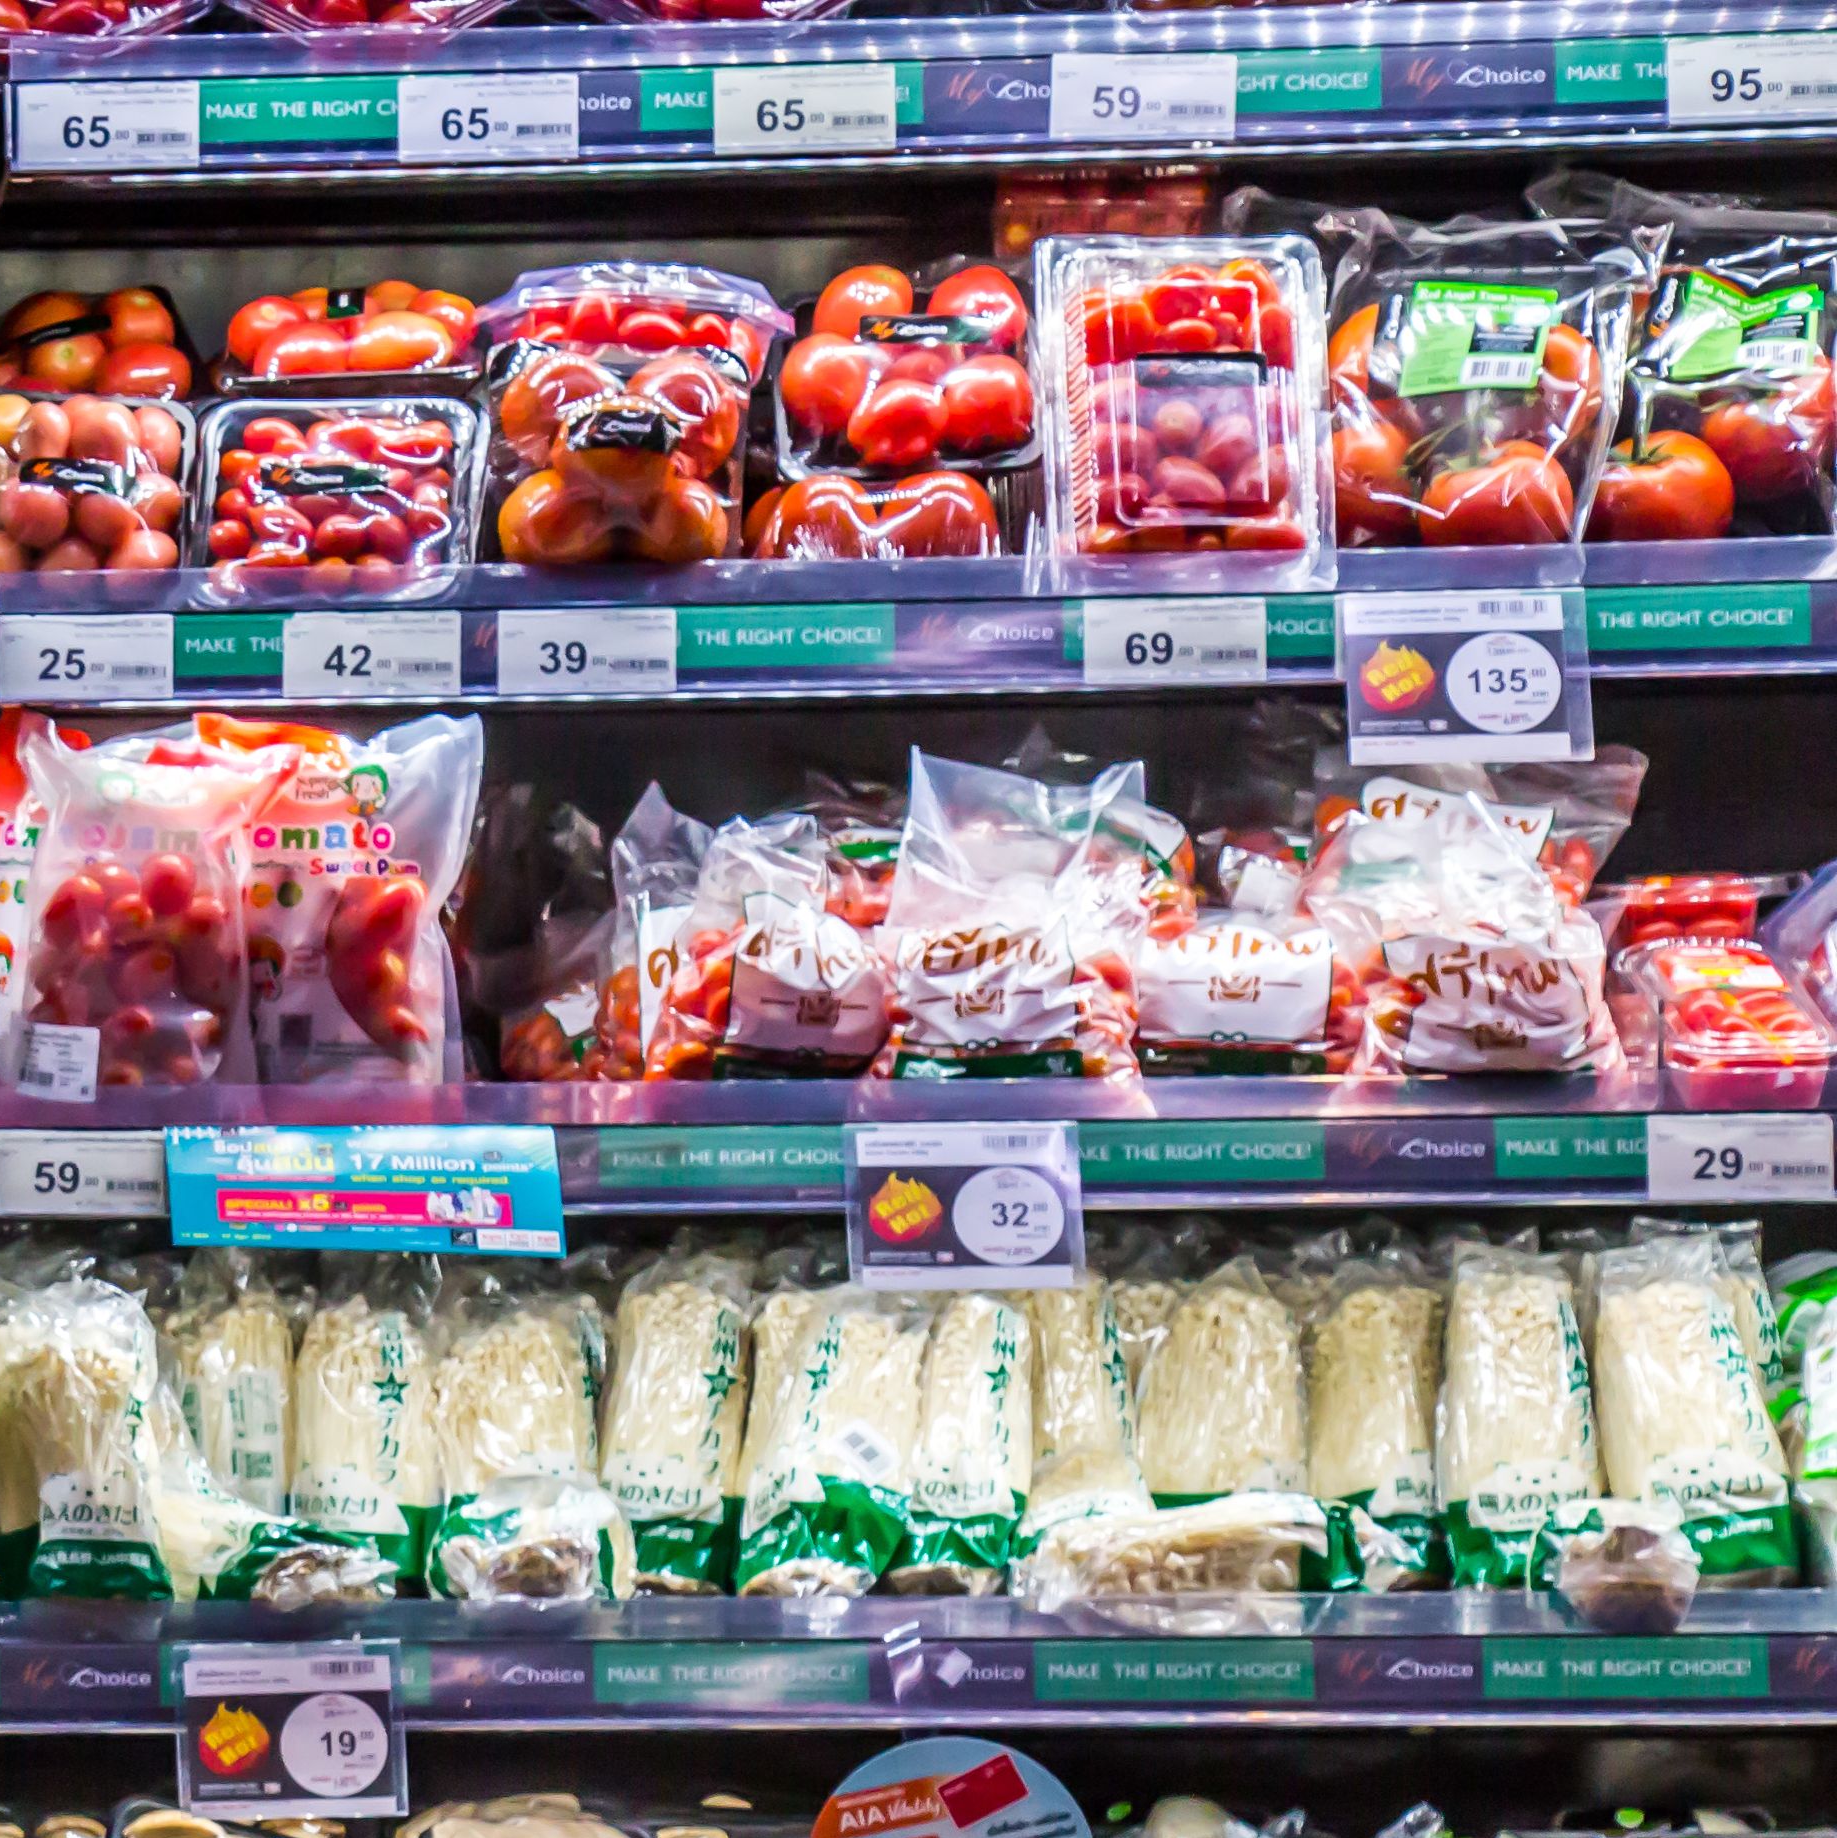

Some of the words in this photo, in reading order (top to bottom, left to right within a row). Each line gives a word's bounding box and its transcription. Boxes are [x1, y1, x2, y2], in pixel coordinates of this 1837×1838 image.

[1282, 69, 1368, 92] CHOICE!
[1451, 63, 1547, 88] Choice
[1565, 62, 1623, 82] MAKE
[1634, 61, 1666, 81] TH
[205, 101, 257, 119] MAKE
[271, 99, 308, 118] THE
[311, 97, 371, 117] RIGHT
[1596, 610, 1635, 631] THE
[1639, 609, 1702, 630] RIGHT
[1707, 607, 1794, 629] CHOICE!
[185, 636, 236, 654] MAKE
[694, 627, 732, 647] THE
[736, 626, 793, 647] RIGHT
[800, 625, 883, 646] CHOICE!
[250, 821, 396, 851] omato
[1164, 1142, 1223, 1162] RIGHT
[1229, 1140, 1313, 1161] CHOICE!
[838, 1805, 886, 1833] AIA
